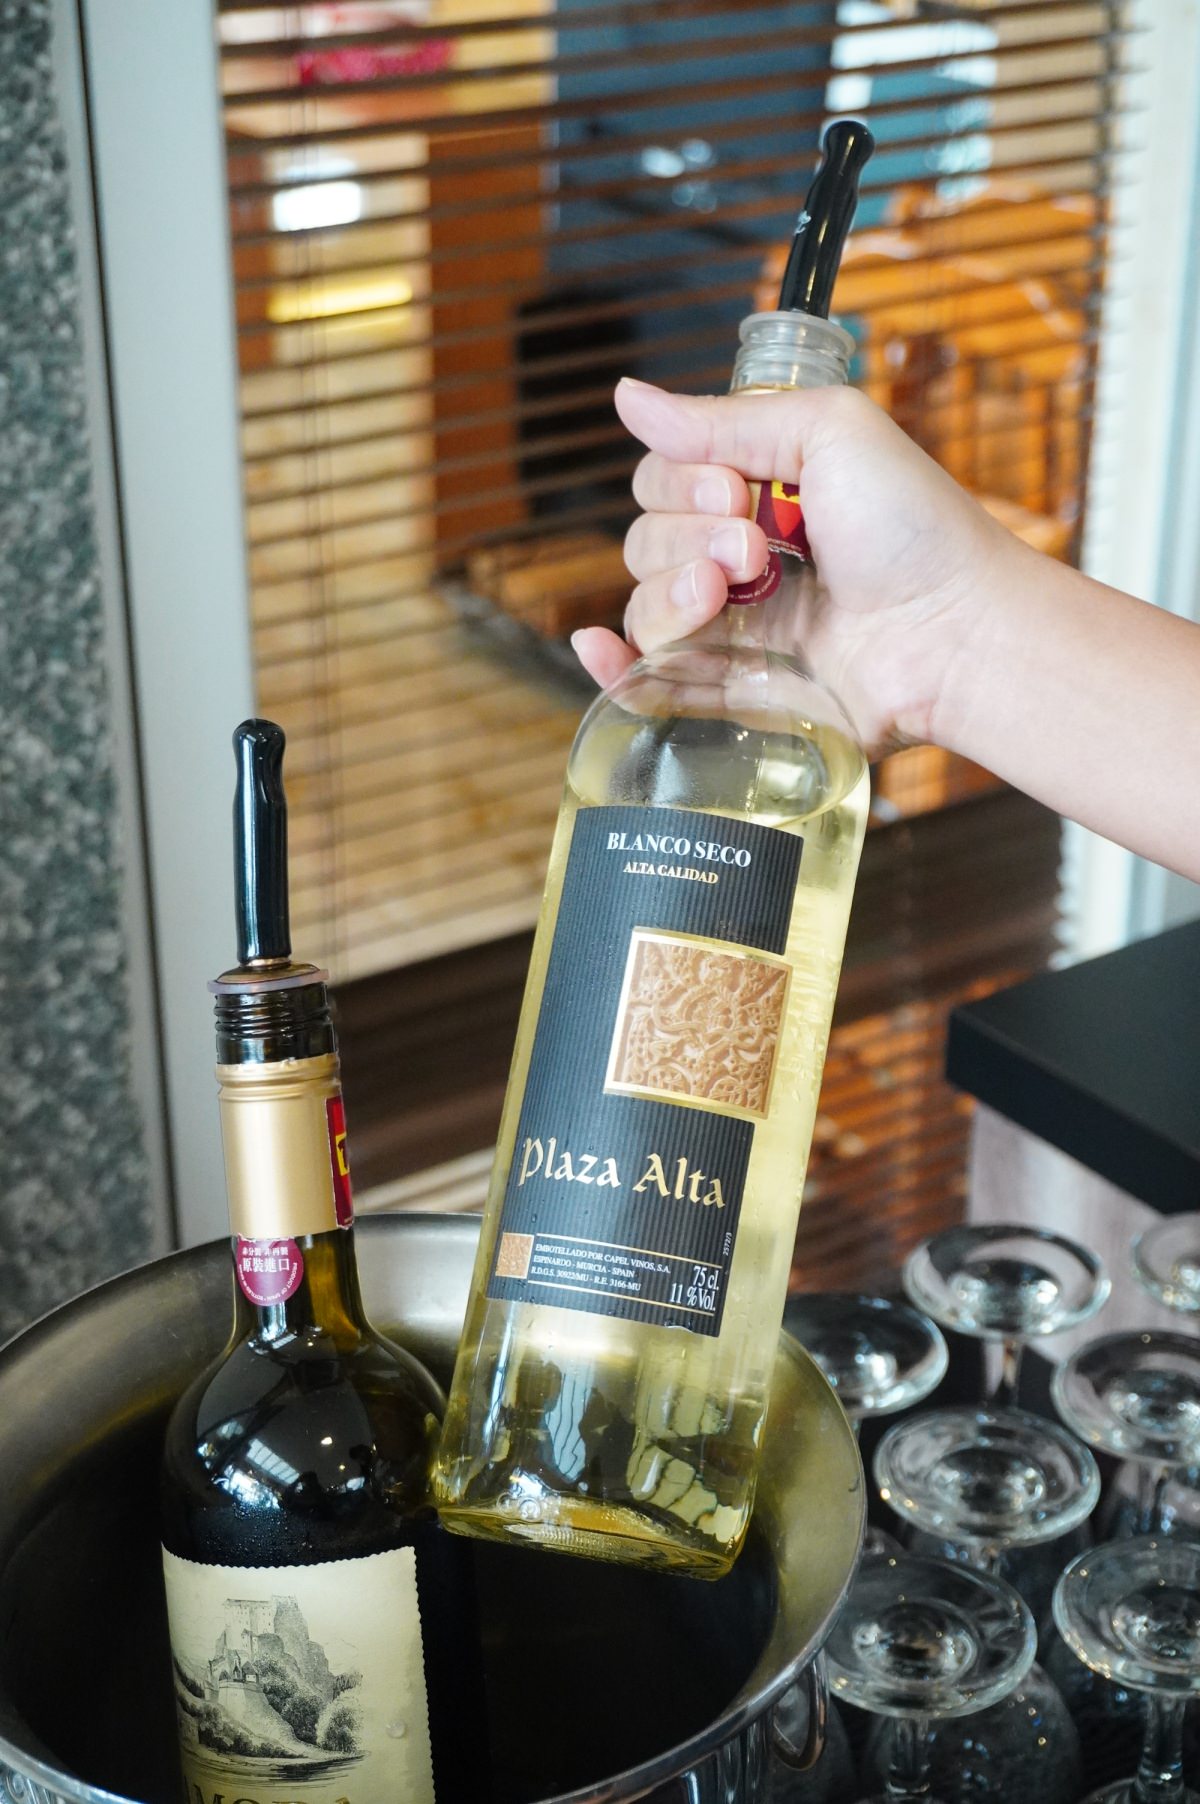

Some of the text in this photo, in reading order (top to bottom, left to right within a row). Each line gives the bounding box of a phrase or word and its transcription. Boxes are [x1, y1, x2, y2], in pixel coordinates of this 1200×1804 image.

[607, 832, 752, 868] BLANCO SECO
[623, 861, 719, 885] ALTA CALIDAD
[518, 1136, 726, 1209] Plaza Alta
[242, 1257, 290, 1273] 原裝進口
[533, 1254, 572, 1267] ESPINARDO
[576, 1260, 607, 1273] MURCIA
[612, 1266, 636, 1278] SPAIN
[535, 1243, 671, 1274] EMBOTELLADO POR CAPEL VINOS, S.A.
[593, 1275, 608, 1286] R.E.
[609, 1278, 642, 1291] 3166-MU
[692, 1265, 720, 1291] 75 cl.
[669, 1282, 684, 1304] 11
